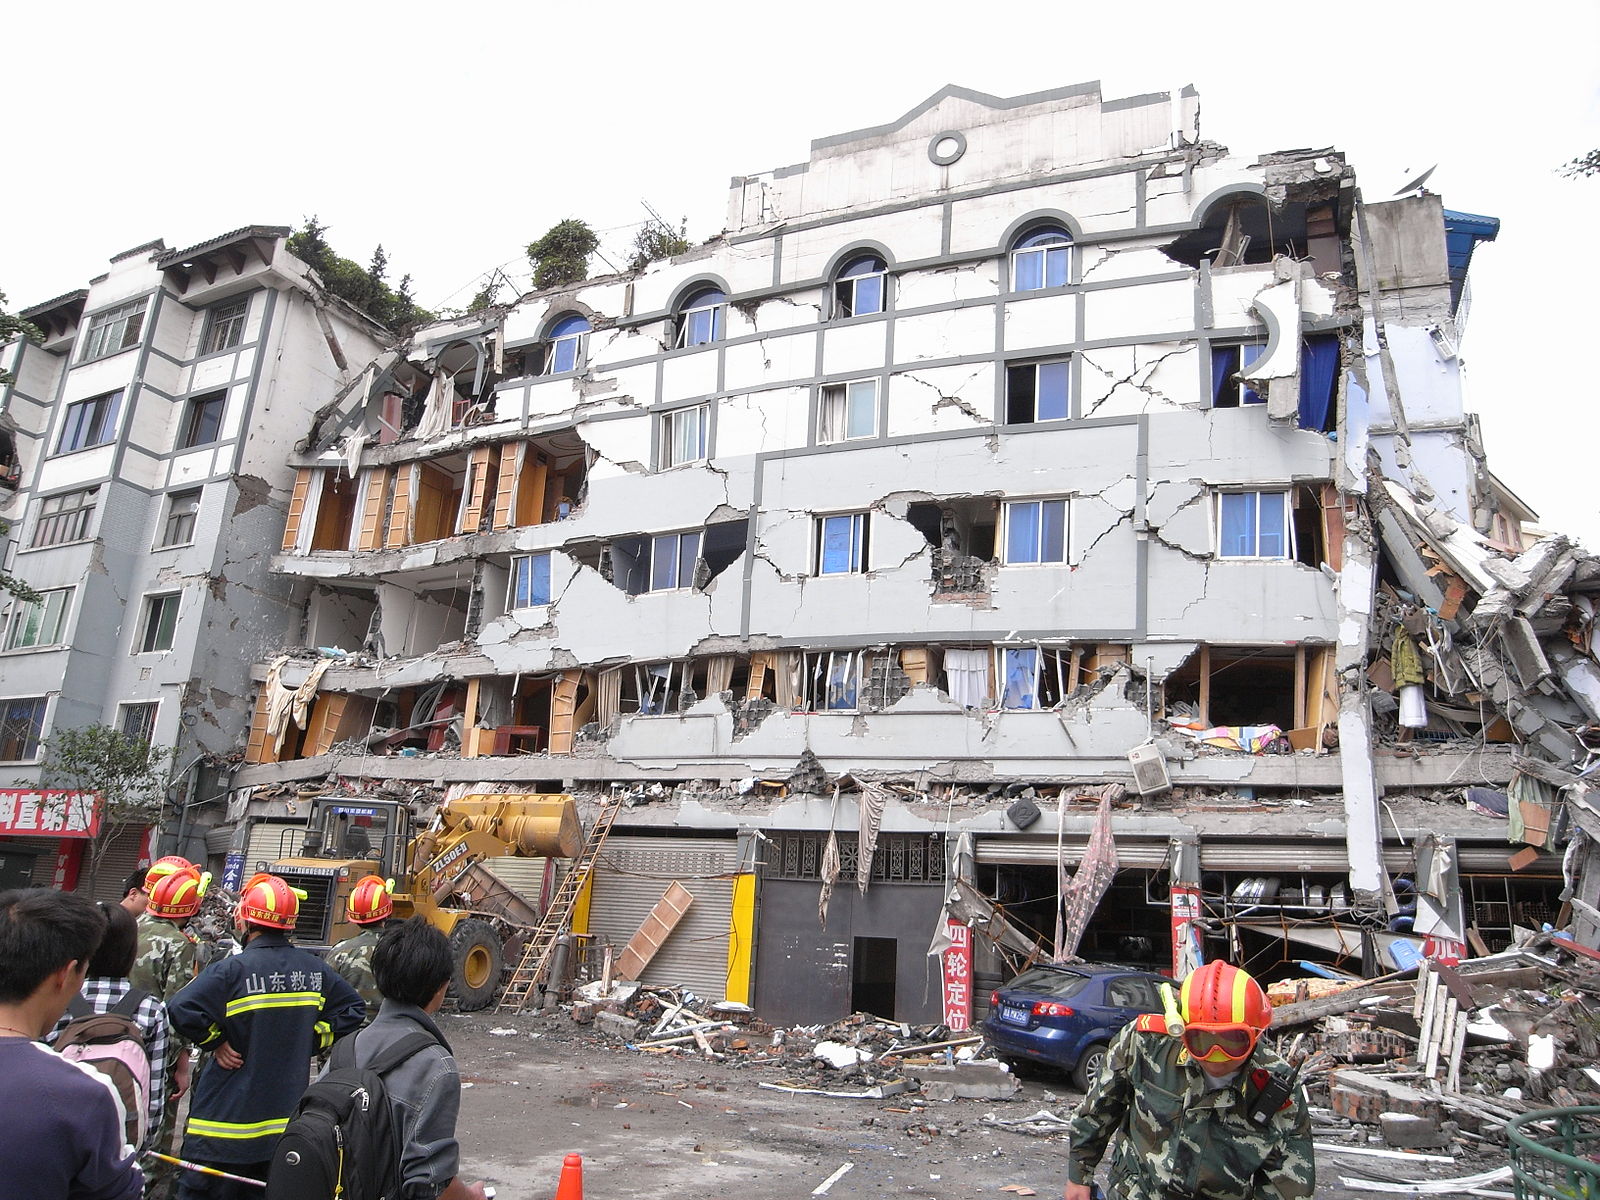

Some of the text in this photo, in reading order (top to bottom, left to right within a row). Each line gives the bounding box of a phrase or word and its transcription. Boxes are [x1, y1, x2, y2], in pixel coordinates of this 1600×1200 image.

[245, 970, 323, 994] 山东救援
[947, 925, 967, 1032] 四轮定位
